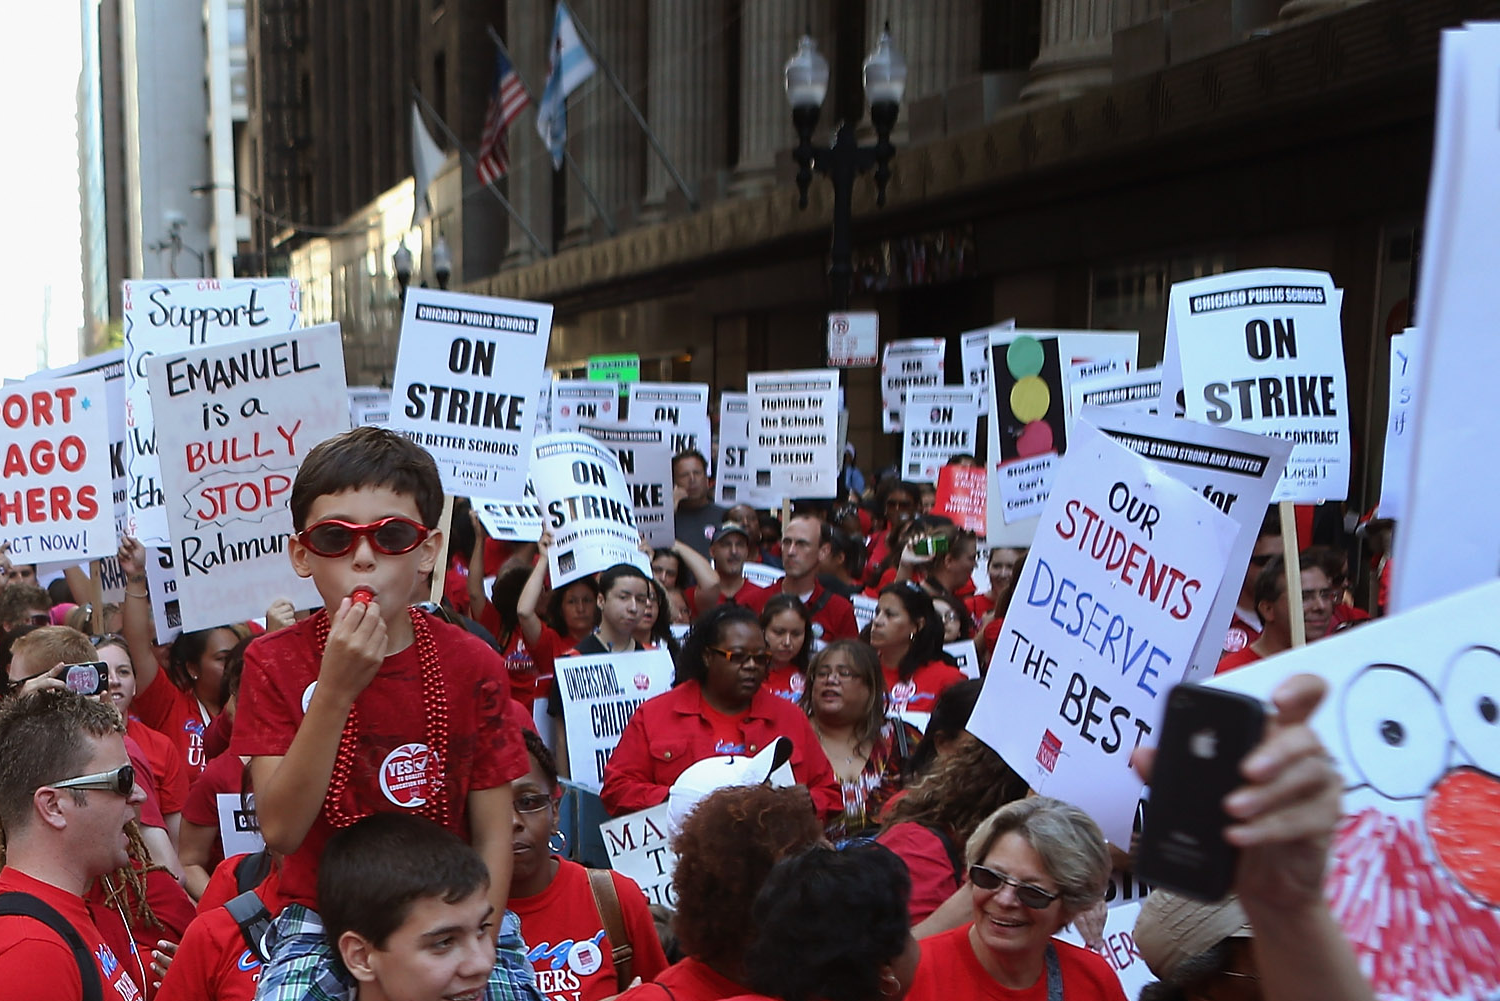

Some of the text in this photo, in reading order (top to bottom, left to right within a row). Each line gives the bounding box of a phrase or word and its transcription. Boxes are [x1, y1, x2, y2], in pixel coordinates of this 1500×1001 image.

[1194, 287, 1324, 312] CHICAGO PUBLIC SCHOOLS
[149, 288, 269, 345] Support
[419, 306, 535, 332] CHICAGO PUBLIC SCHOOLS
[1245, 318, 1297, 360] ON
[166, 339, 320, 397] EMANUEL
[448, 337, 496, 377] ON
[888, 375, 938, 390] CONTRACT
[1086, 382, 1161, 405] CHICAGO PUBLIC
[405, 383, 525, 432] STRIKE
[761, 398, 806, 411] Fighting
[808, 397, 823, 408] for
[1203, 376, 1337, 425] STRIKE
[202, 397, 269, 431] is a
[655, 406, 680, 426] ON
[761, 415, 825, 428] the Schools
[930, 406, 954, 424] ON
[186, 420, 302, 473] BULLY
[426, 432, 465, 450] BETTER
[468, 438, 518, 456] SCHOOLS
[758, 434, 827, 446] Our Students
[911, 430, 969, 448] STRIKE
[1284, 430, 1339, 445] CONTRACT
[771, 452, 814, 465] DESERVE
[1149, 441, 1261, 473] STAND STRONG AND UNITED
[453, 465, 488, 481] Local
[571, 461, 607, 487] ON
[1284, 465, 1316, 480] Local
[197, 474, 292, 522] STOP
[547, 495, 637, 529] STRIKE
[1108, 482, 1160, 541] OUR
[40, 530, 88, 554] NOW!
[1055, 500, 1201, 620] STUDENTS
[1027, 558, 1172, 698] DESERVE
[1012, 629, 1153, 768] THE BEST
[387, 760, 414, 777] YES
